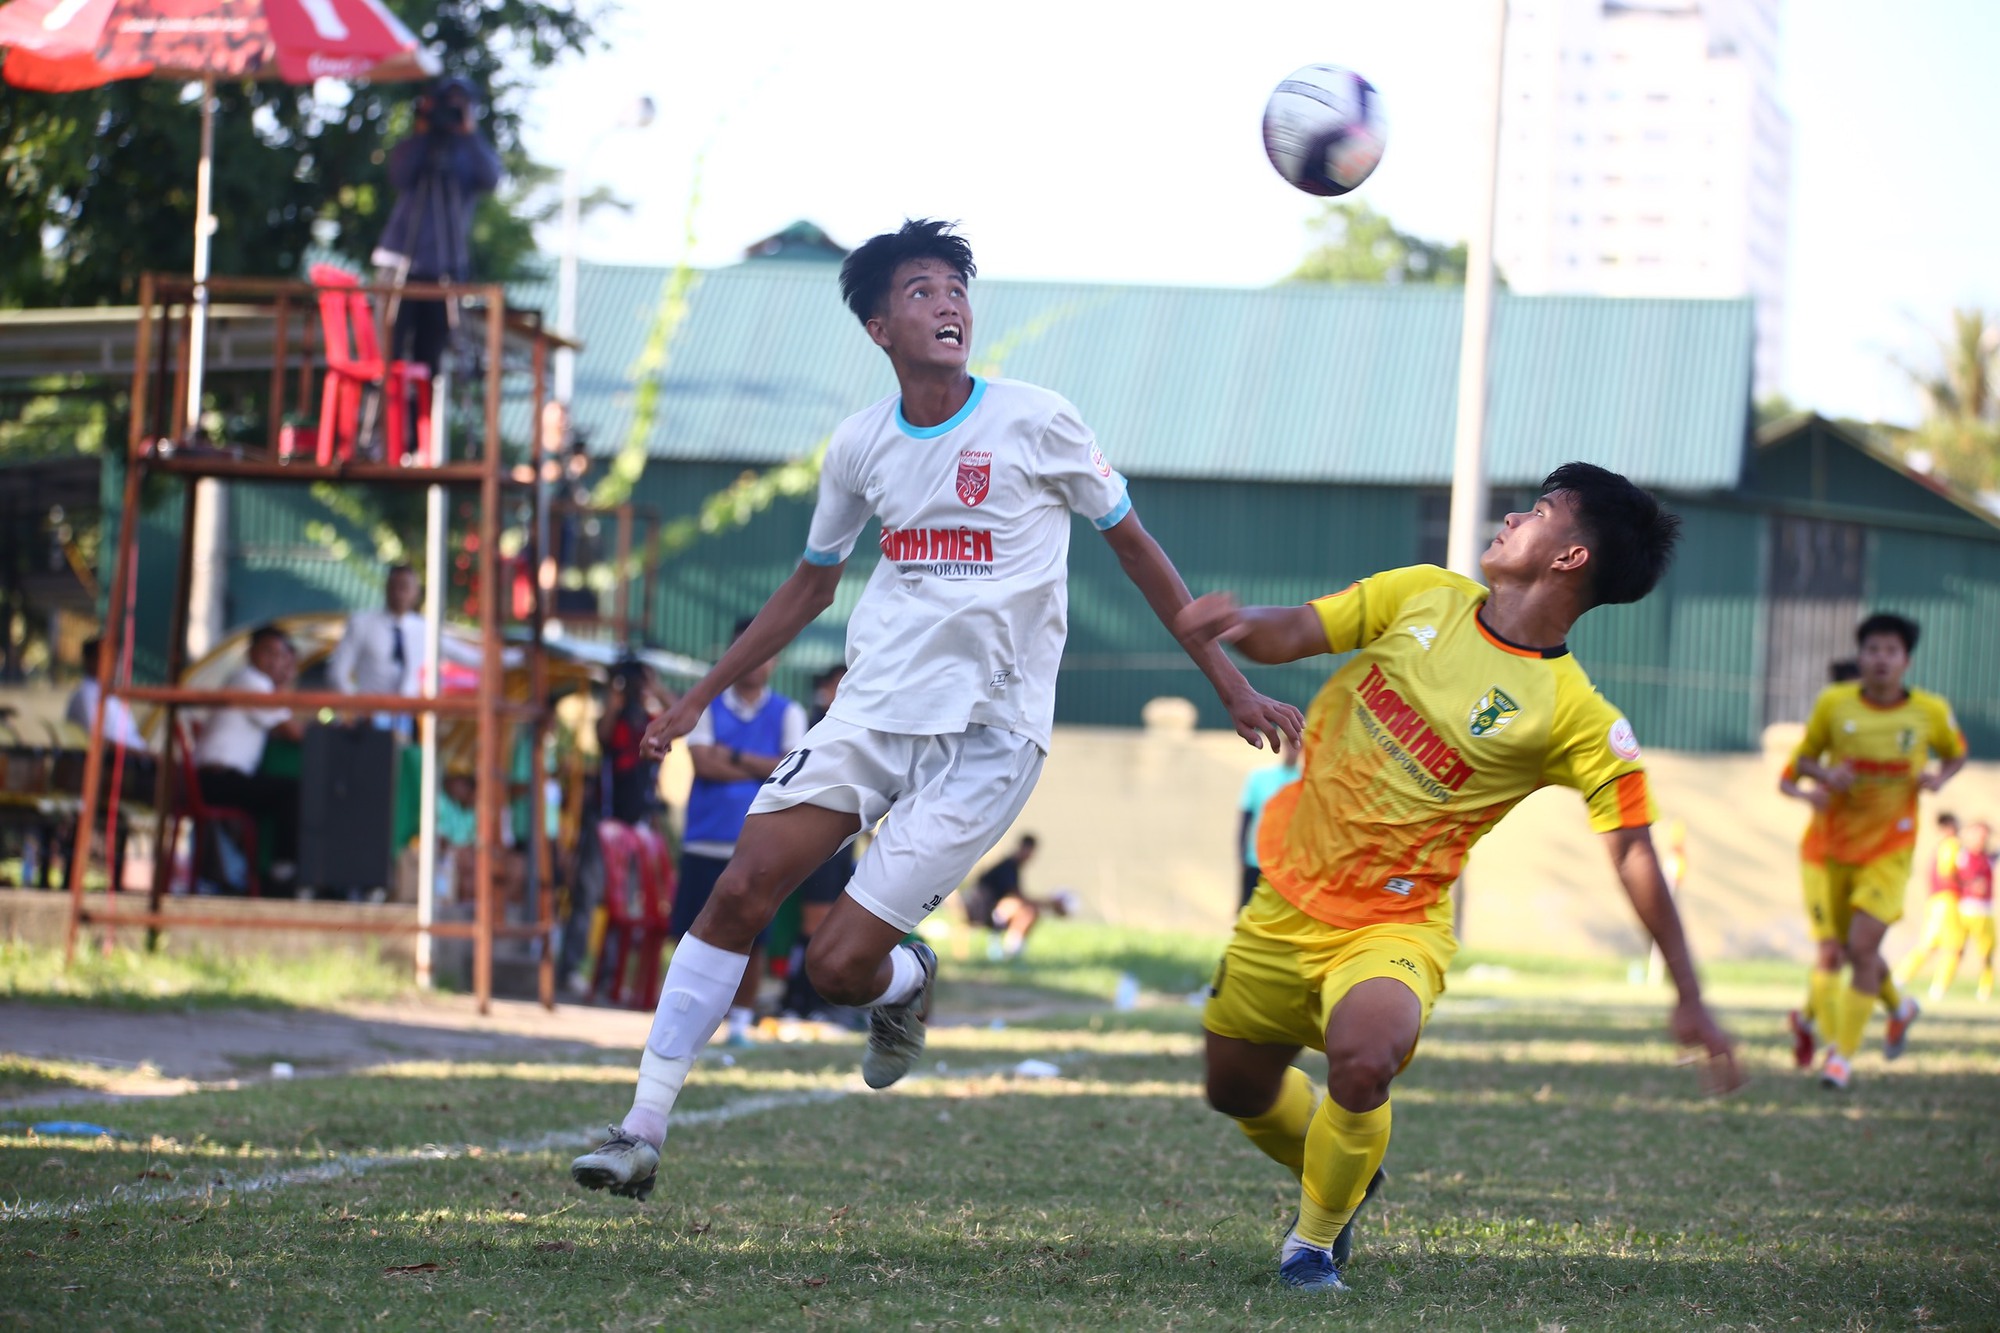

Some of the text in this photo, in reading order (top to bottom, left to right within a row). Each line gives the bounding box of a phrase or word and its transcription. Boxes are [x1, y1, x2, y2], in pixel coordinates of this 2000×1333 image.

[930, 525, 993, 562] NIÊN
[1356, 662, 1476, 792] THANH NIÊN
[1377, 734, 1452, 804] CORPORATION
